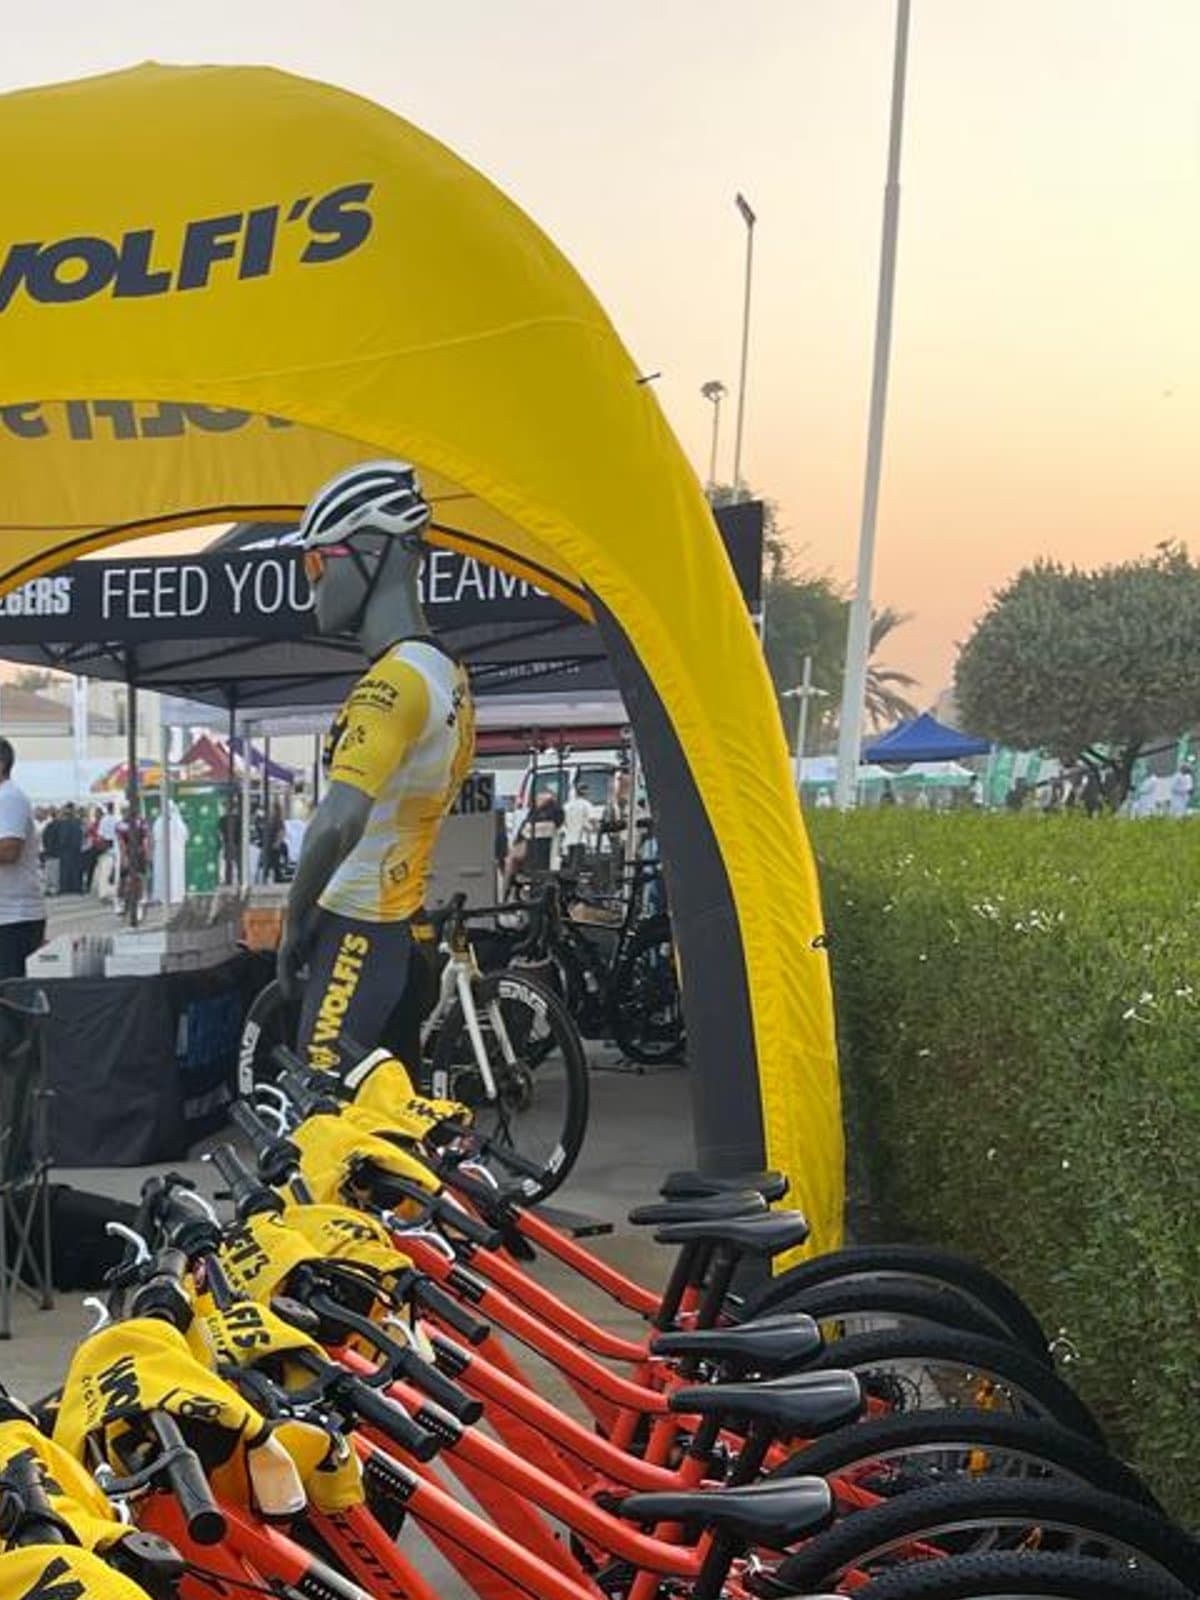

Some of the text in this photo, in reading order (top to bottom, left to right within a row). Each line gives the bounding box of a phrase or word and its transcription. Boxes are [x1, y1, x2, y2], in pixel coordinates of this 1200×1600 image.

[103, 566, 208, 618] FEED
[224, 560, 315, 614] YOU
[314, 933, 370, 1042] WOLFI'S
